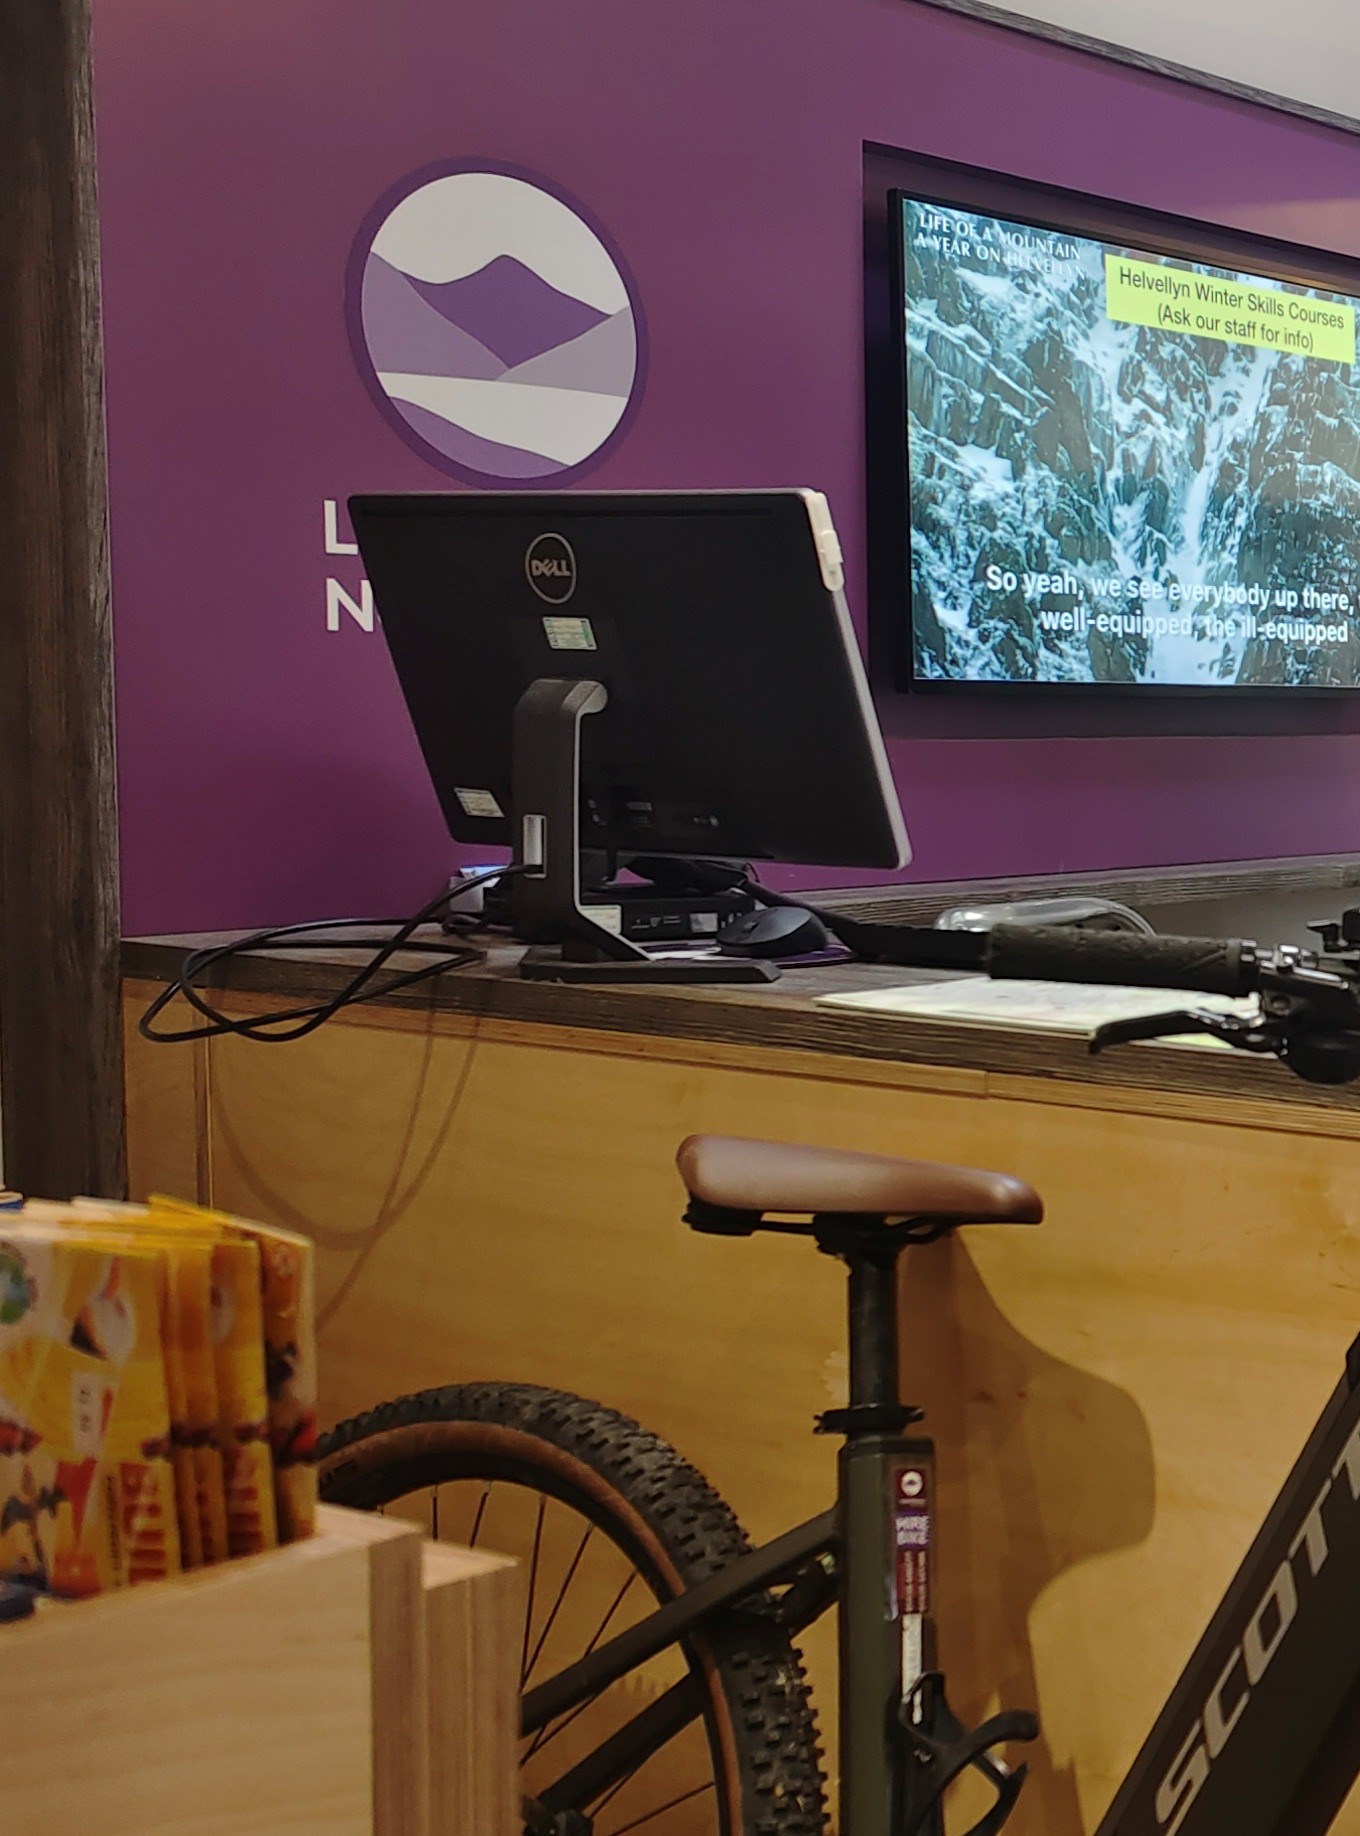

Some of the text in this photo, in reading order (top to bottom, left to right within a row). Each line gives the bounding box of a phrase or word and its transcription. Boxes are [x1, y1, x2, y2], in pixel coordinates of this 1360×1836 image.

[914, 232, 1086, 281] A YEAR ON HELVELLYN
[919, 212, 1081, 261] LIFE OF A MOUNTAIN
[1118, 265, 1345, 329] Helvellyn Winter Skills Courses
[1157, 302, 1315, 354] (Ask our staff for info)
[531, 558, 572, 577] DELL
[986, 564, 1017, 593] So
[1022, 568, 1085, 601] yeah,
[1092, 577, 1122, 600] we
[1126, 578, 1165, 601] see
[1168, 575, 1272, 608] everybody
[1274, 585, 1299, 612] up
[1301, 585, 1356, 615] there,
[1040, 607, 1350, 645] well-equipped, the ill-equipped
